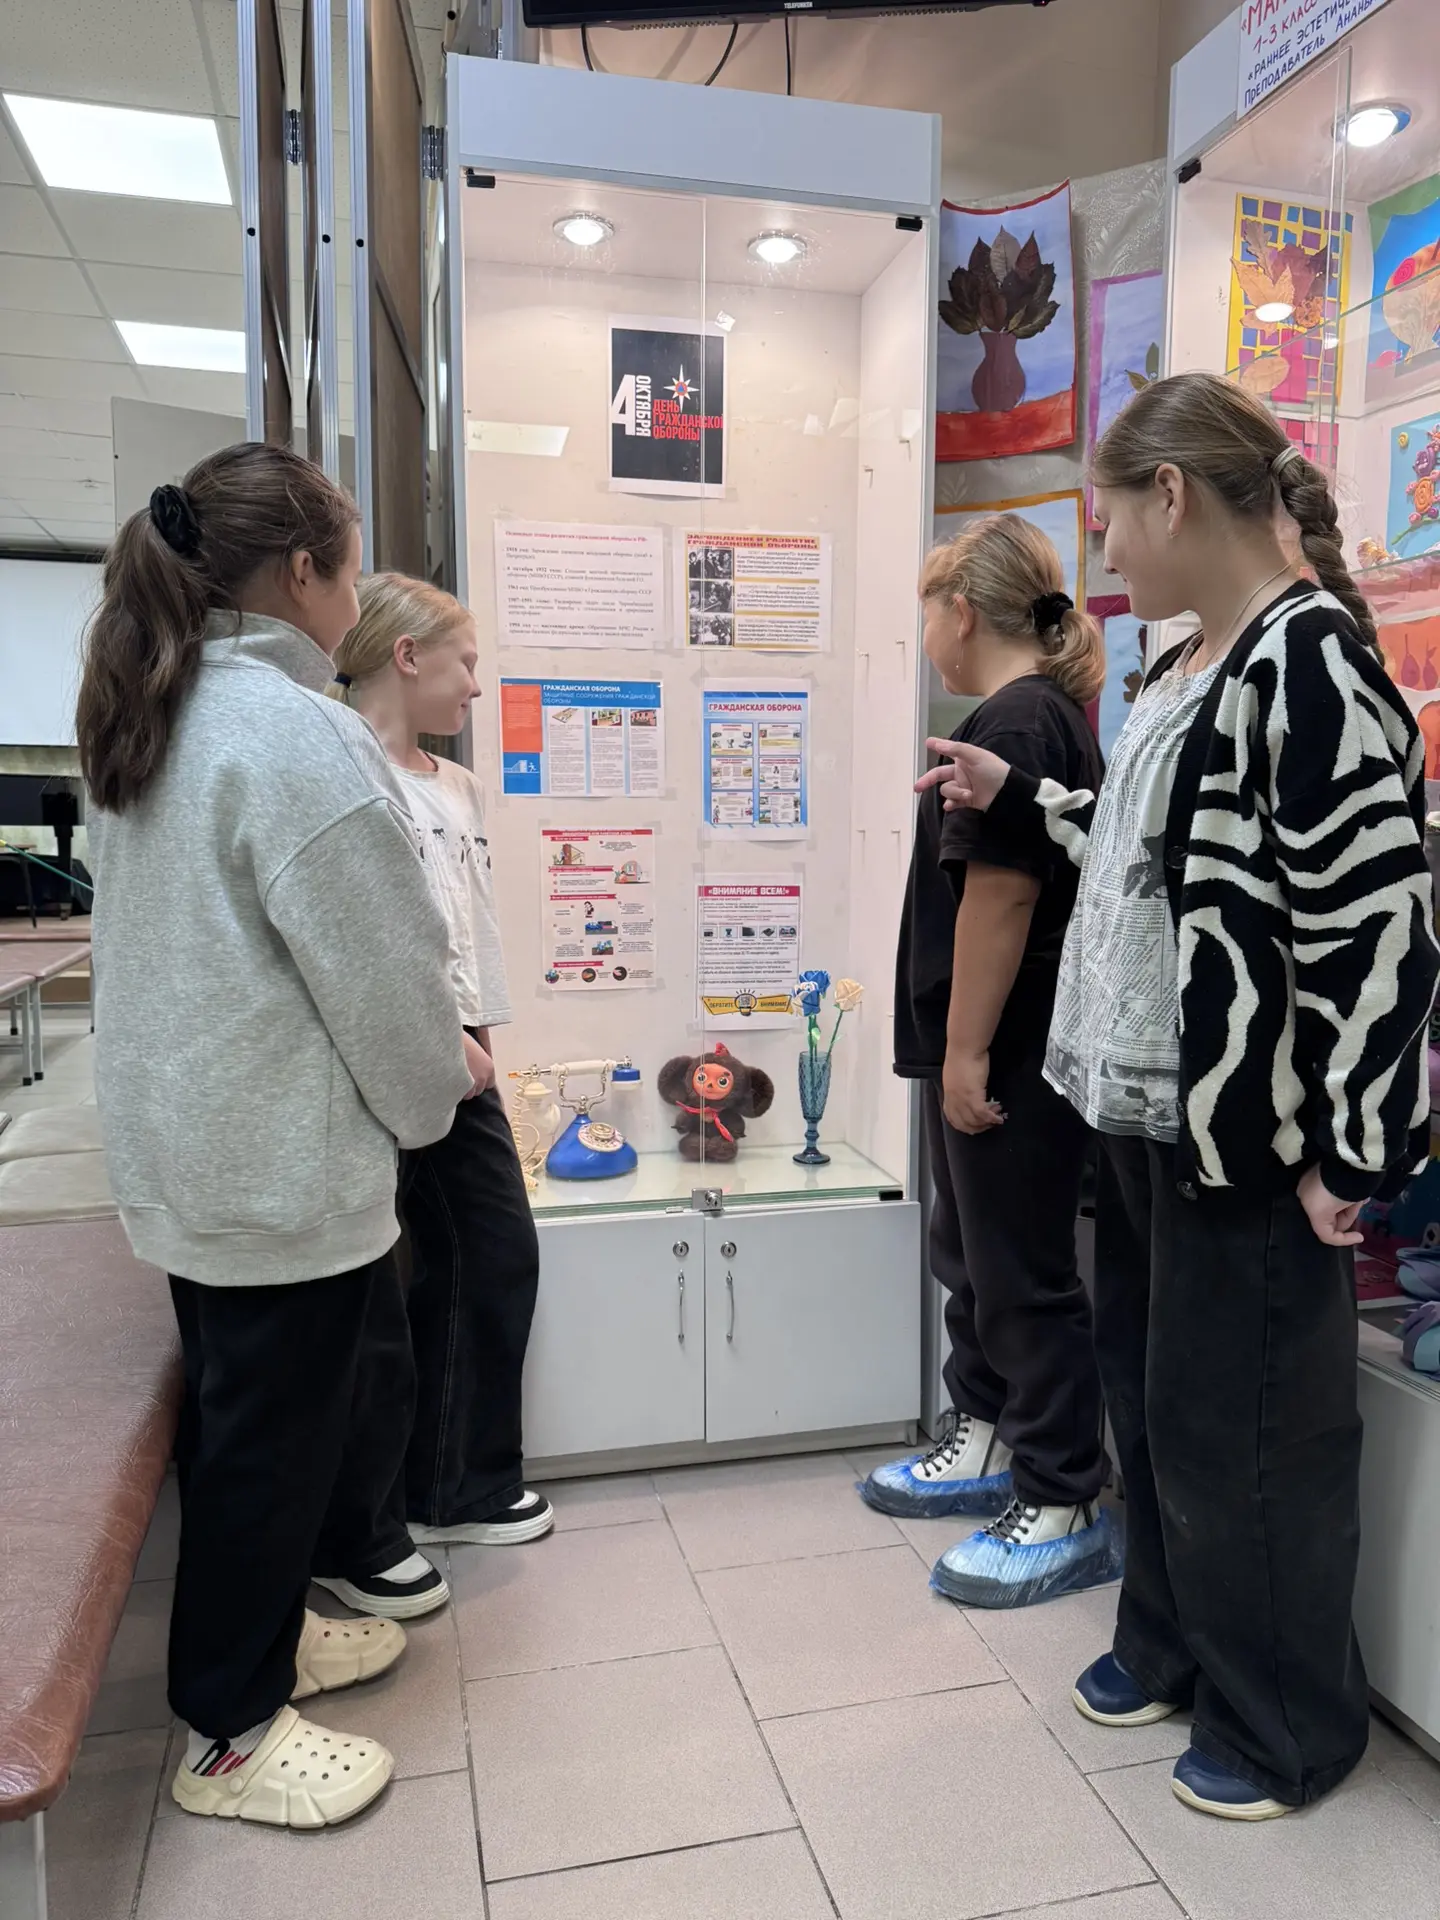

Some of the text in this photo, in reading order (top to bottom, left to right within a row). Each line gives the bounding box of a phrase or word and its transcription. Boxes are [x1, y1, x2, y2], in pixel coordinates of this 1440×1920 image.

[1253, 23, 1278, 53] 1-3
[1244, 33, 1325, 108] ПРЕПОДАВАТЕЛЬ
[1248, 39, 1292, 81] «РАННЕЕ
[610, 374, 651, 437] 4 ОКТЯБРЯ
[652, 399, 680, 414] ДЕНЬ
[652, 425, 700, 441] ОБОРОНЫ
[543, 684, 590, 692] ГРАЖДАНСКАЯ
[709, 704, 802, 712] ГРАЖДАНСКАЯ ОБОРОНА
